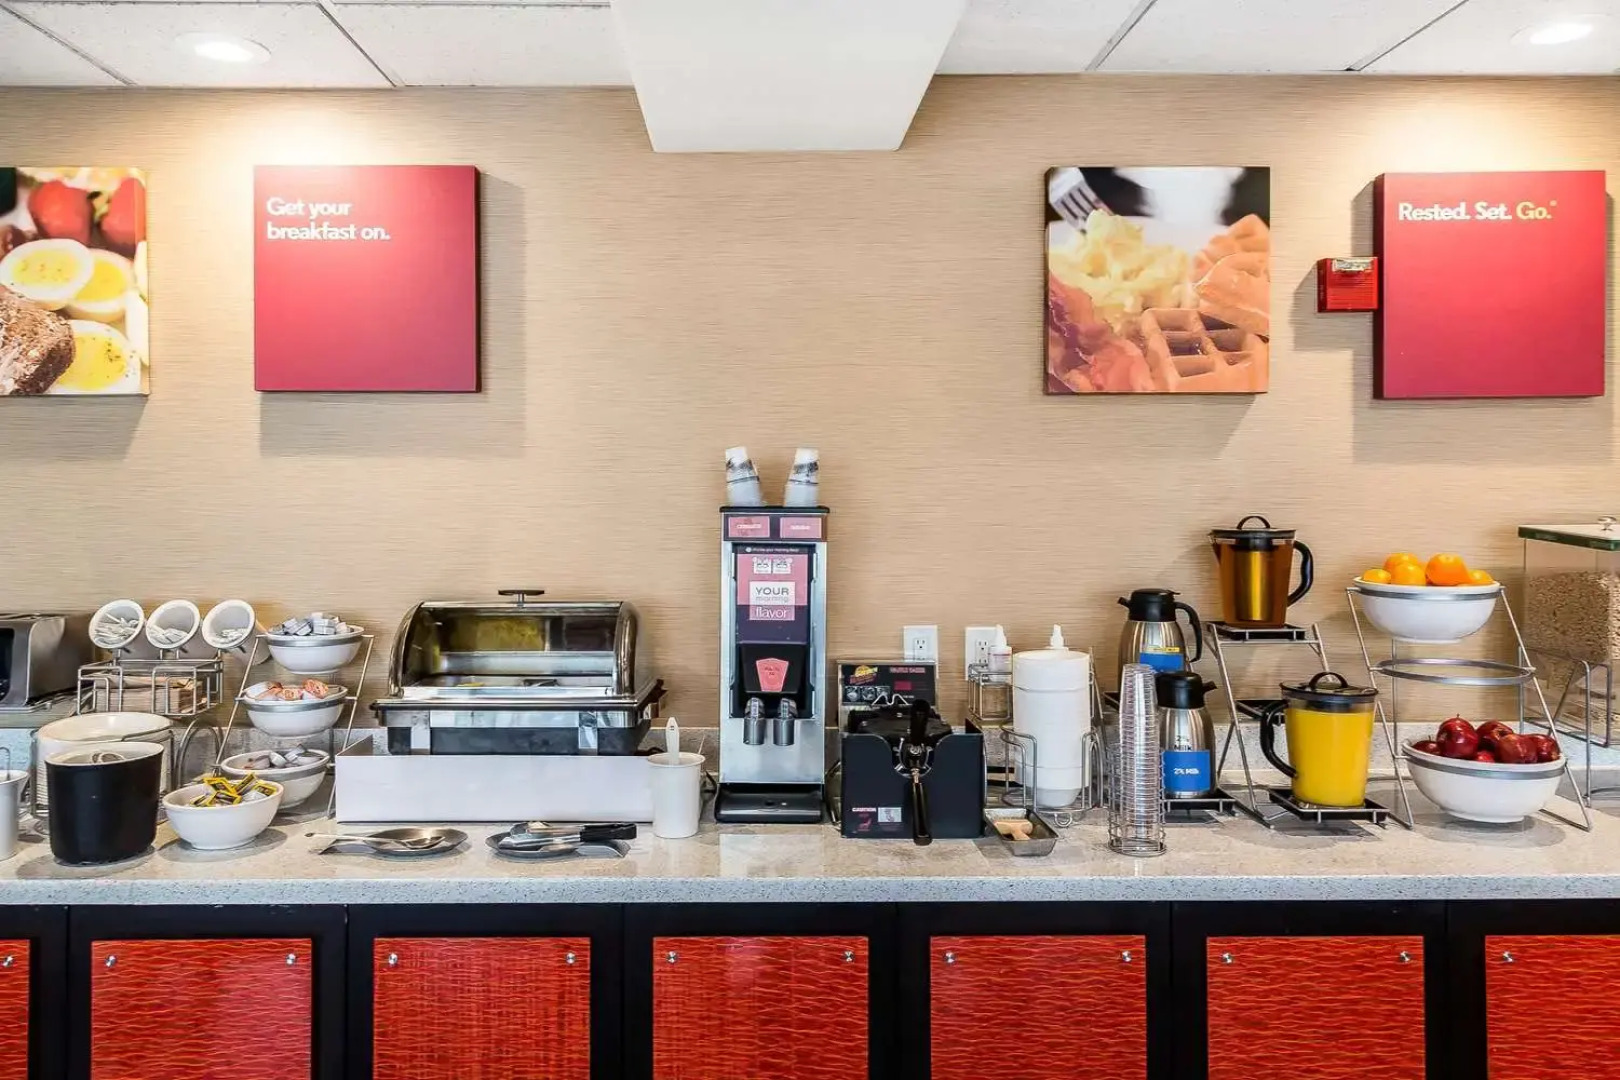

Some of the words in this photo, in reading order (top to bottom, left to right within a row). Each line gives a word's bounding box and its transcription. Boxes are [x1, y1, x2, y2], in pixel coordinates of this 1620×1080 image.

[266, 197, 305, 216] Get
[308, 202, 352, 219] your
[1398, 202, 1471, 221] Rested.
[1474, 201, 1512, 221] Set.
[266, 221, 356, 240] breakfast
[360, 226, 391, 240] on.
[755, 586, 789, 596] YOUR
[756, 606, 787, 619] flavor
